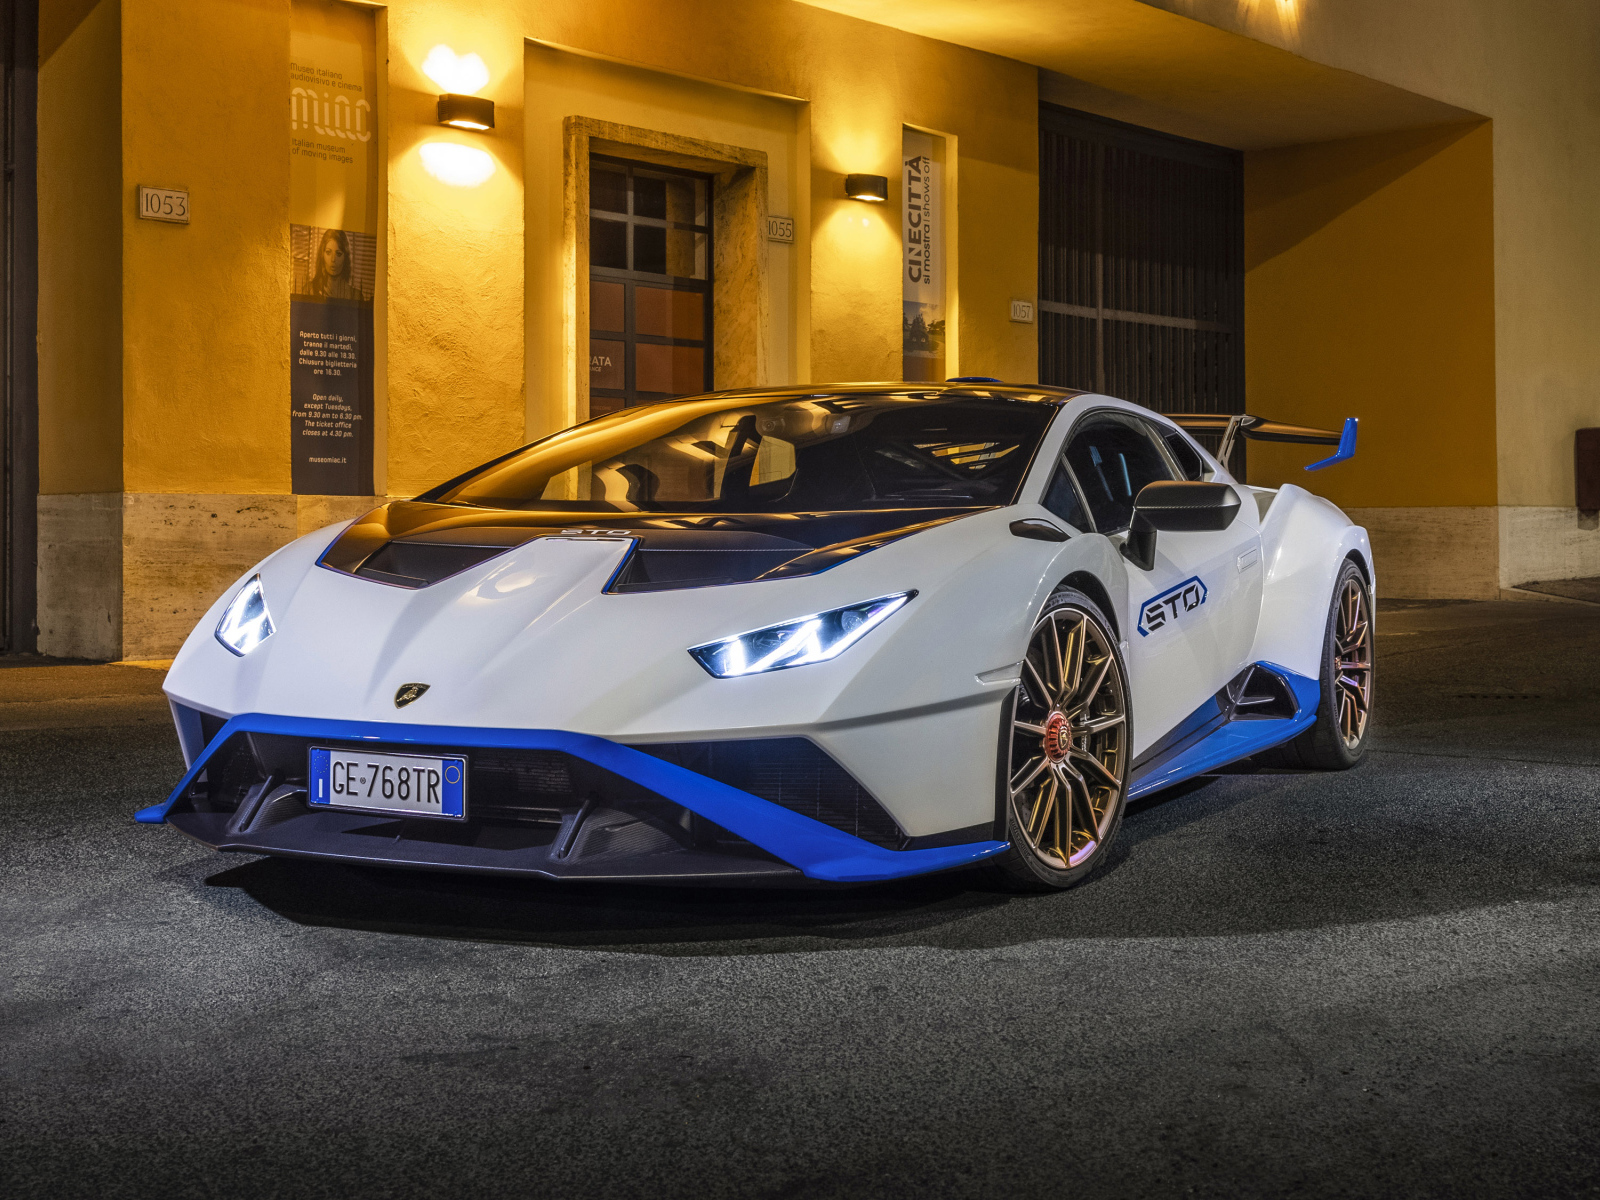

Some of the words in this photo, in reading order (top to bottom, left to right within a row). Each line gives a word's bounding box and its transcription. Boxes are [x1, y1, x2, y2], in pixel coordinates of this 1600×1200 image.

[316, 67, 342, 79] italiano
[290, 72, 330, 86] audiovisivo
[338, 80, 362, 92] cinema
[292, 138, 314, 148] Italian
[316, 142, 345, 153] museum
[302, 149, 327, 160] moving
[329, 152, 353, 164] images
[146, 193, 186, 216] 1053
[905, 156, 922, 282] CINECITTÀ
[769, 220, 792, 237] 1055
[923, 274, 930, 284] si
[1013, 304, 1030, 318] 1057
[300, 331, 320, 339] Aperto
[339, 334, 357, 342] giorni,
[325, 360, 357, 368] biglietteria
[328, 394, 343, 402] daily,
[325, 403, 352, 412] Tuesdays,
[1146, 584, 1200, 631] STO
